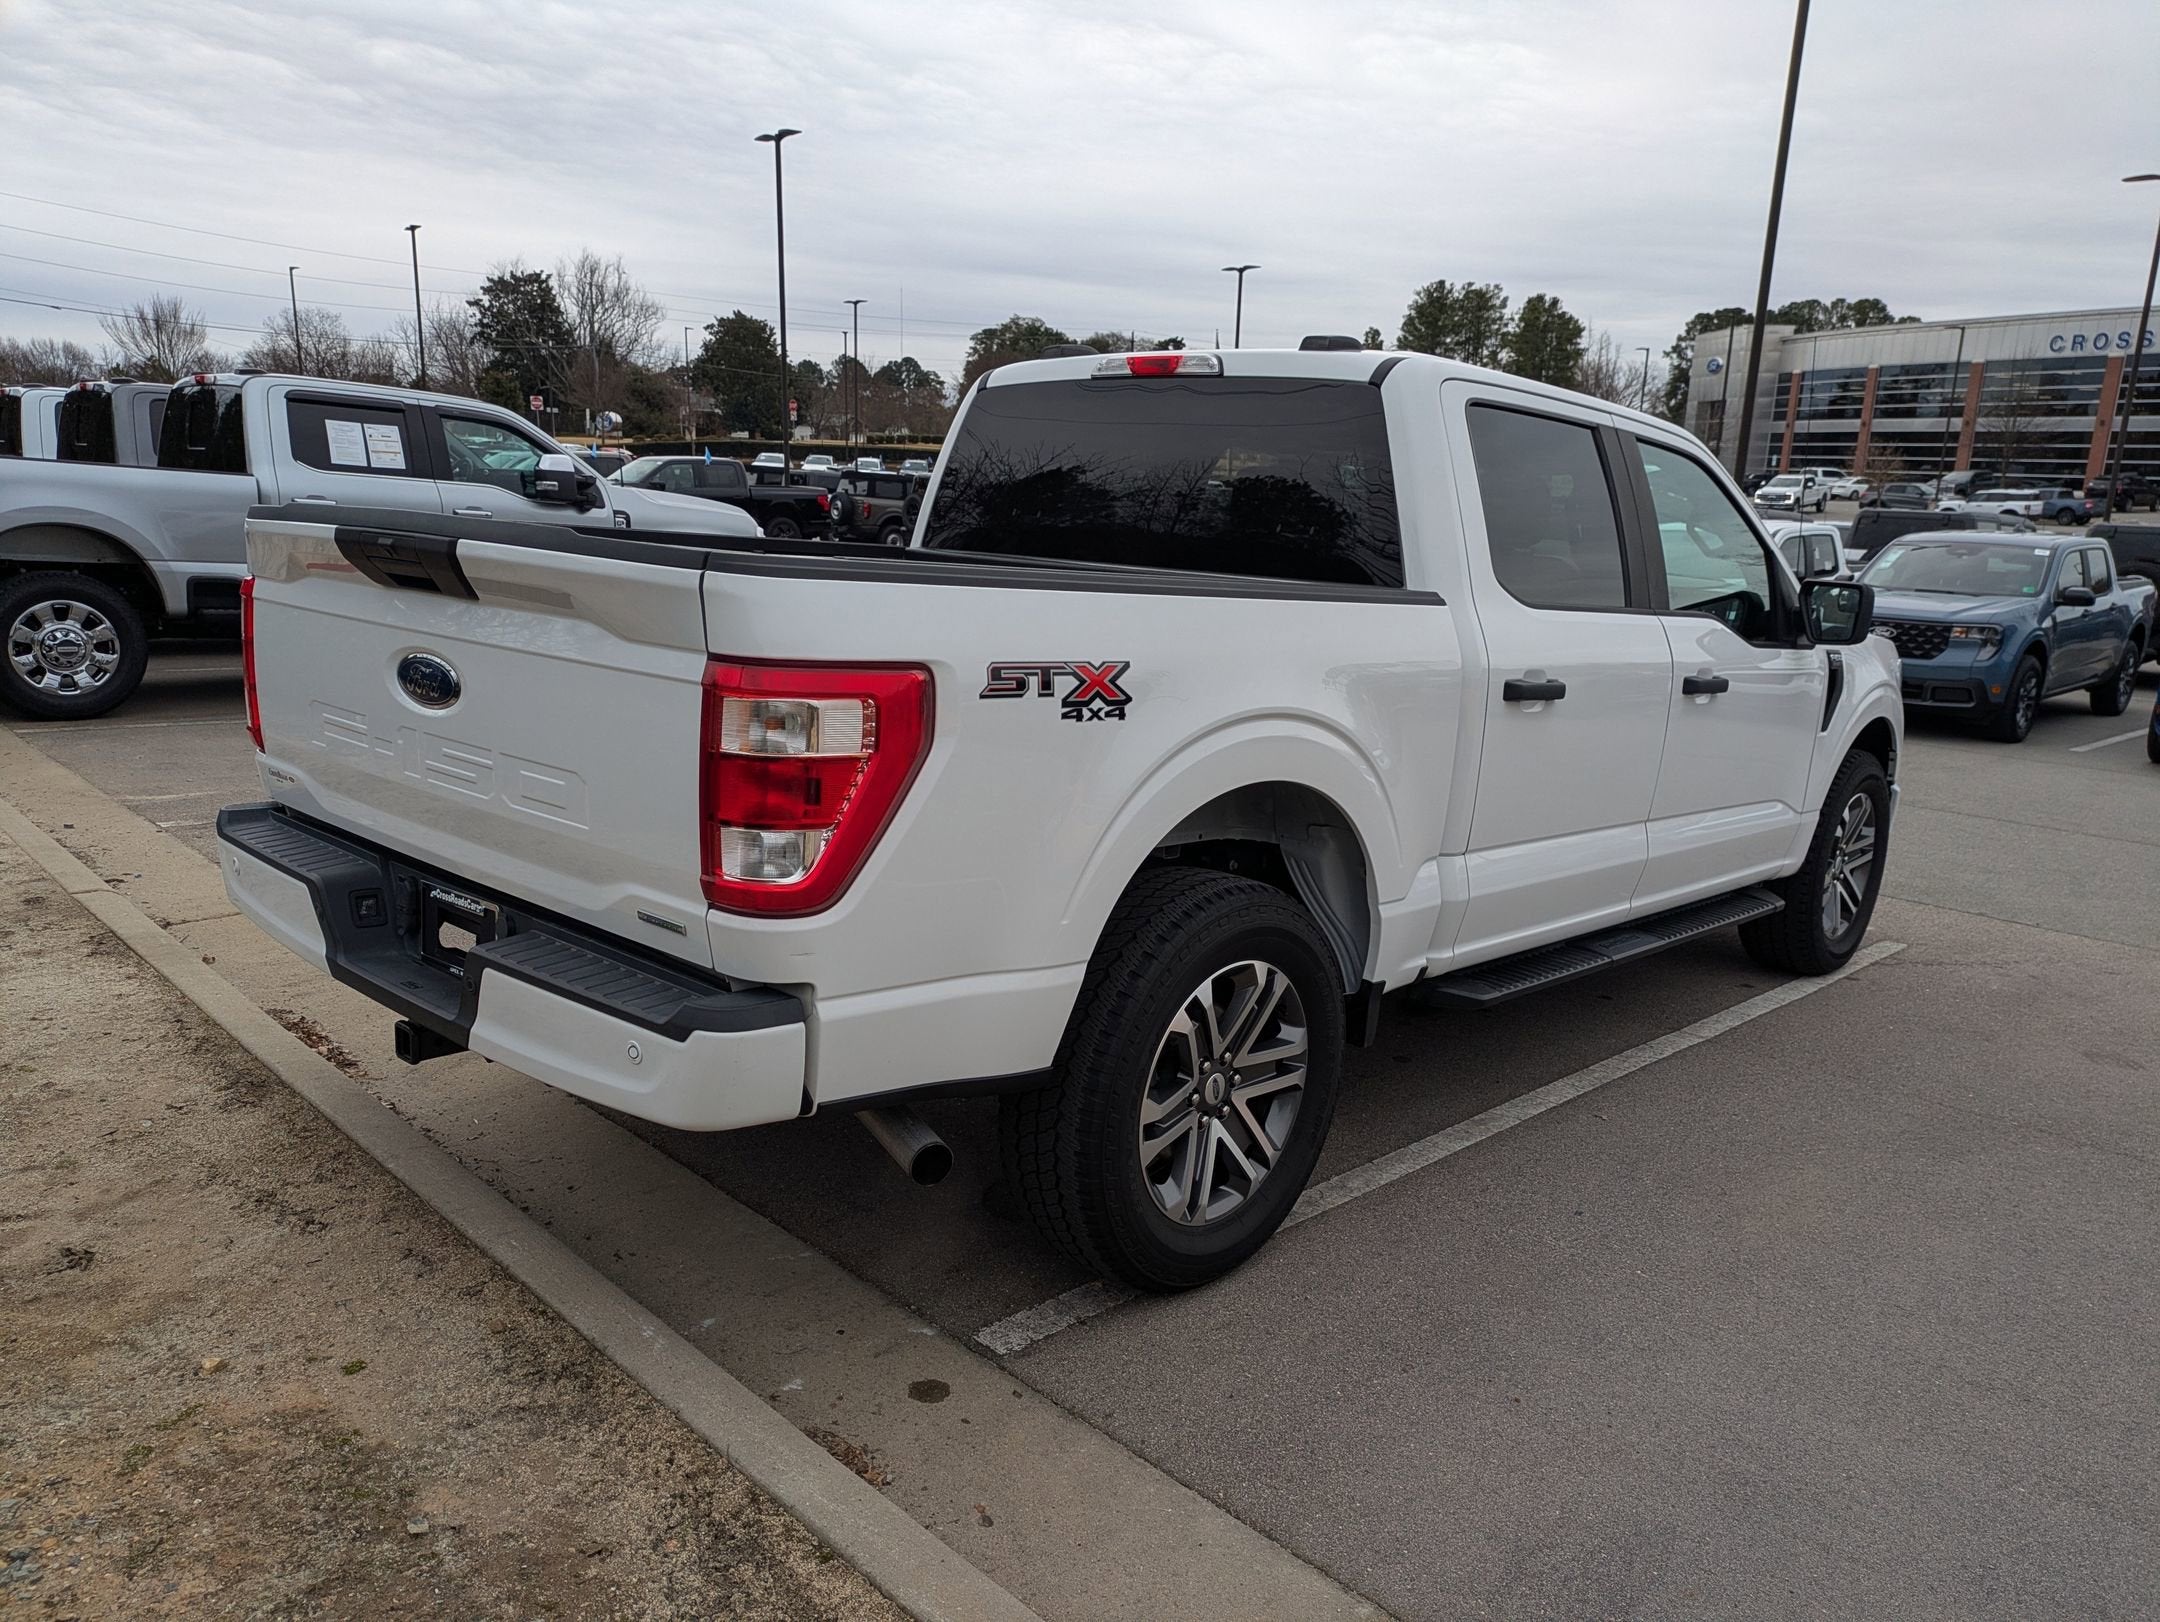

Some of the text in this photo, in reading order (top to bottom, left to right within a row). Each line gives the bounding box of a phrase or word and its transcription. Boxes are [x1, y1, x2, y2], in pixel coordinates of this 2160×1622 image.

[2049, 330, 2155, 353] CROSS
[979, 661, 1133, 708] STX
[309, 700, 590, 830] F-150
